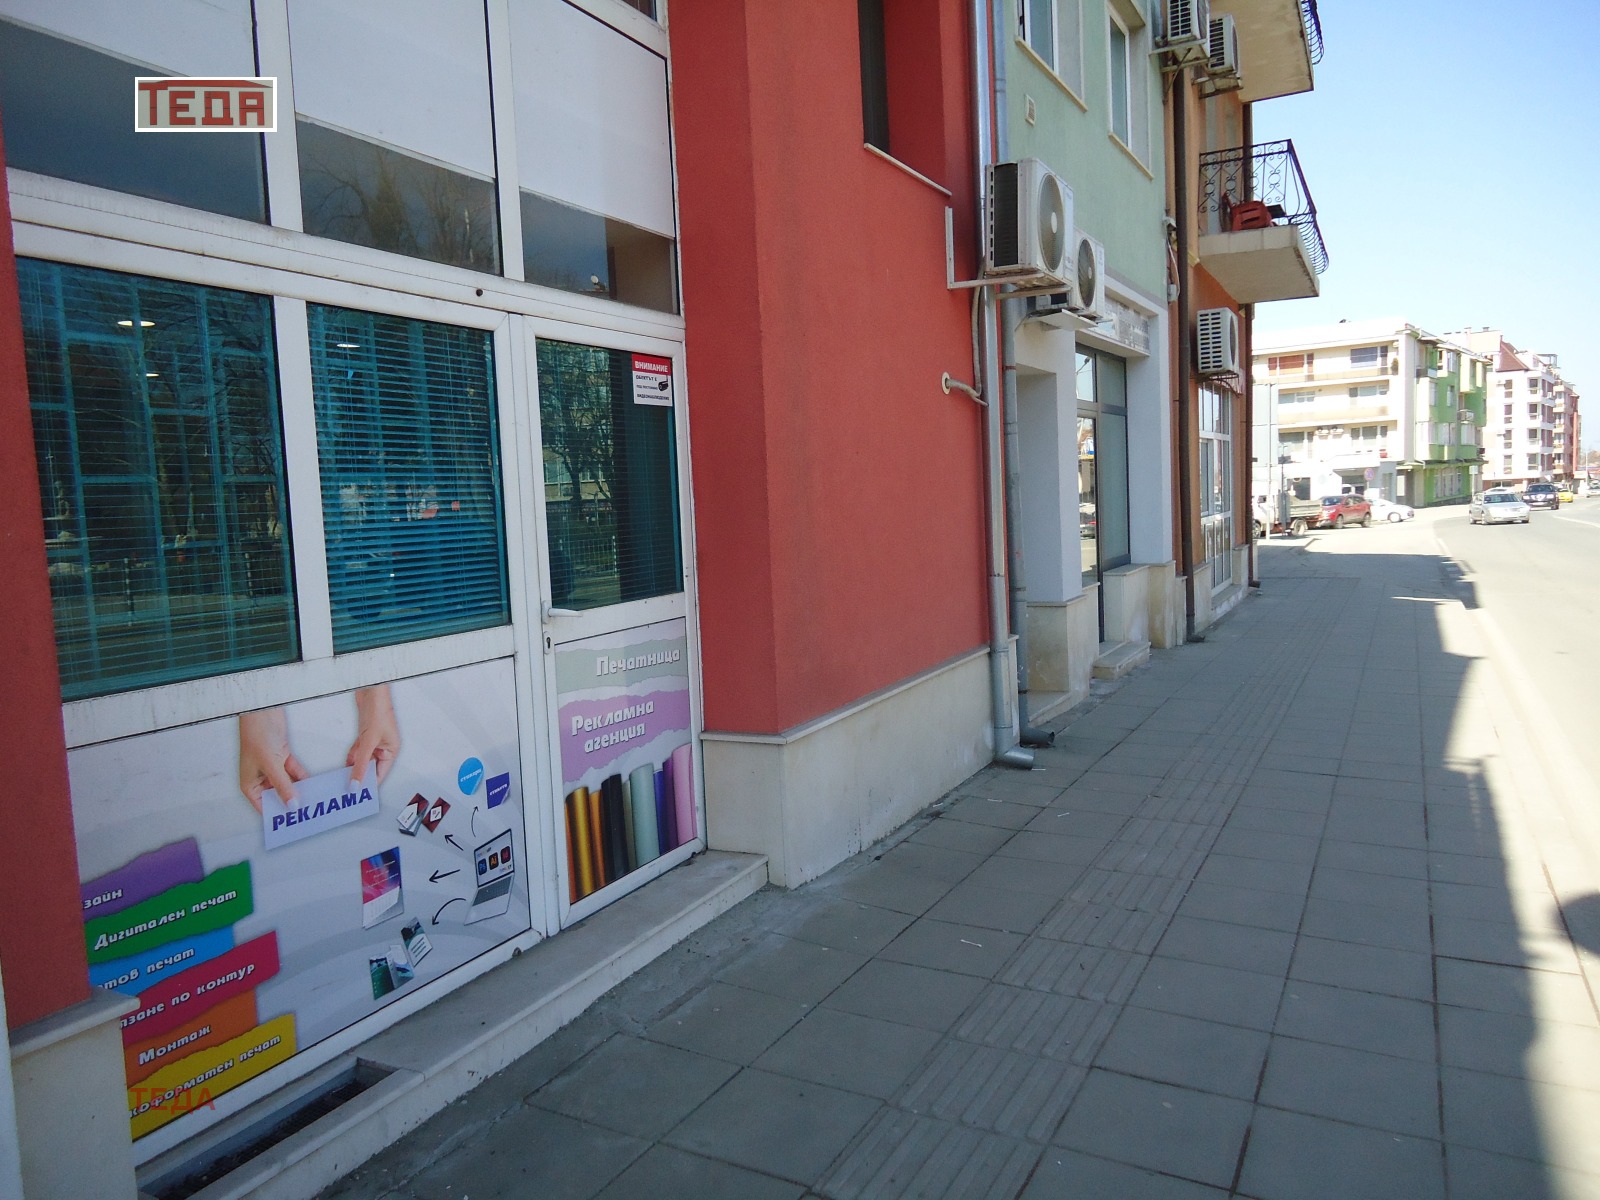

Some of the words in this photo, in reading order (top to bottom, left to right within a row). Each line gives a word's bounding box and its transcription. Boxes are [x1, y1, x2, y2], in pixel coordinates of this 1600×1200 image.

[635, 361, 668, 372] ВНИМАНИЕ
[596, 648, 681, 676] Печатница
[571, 700, 655, 737] Рекламна
[584, 723, 646, 754] агенция
[272, 787, 373, 831] РЕКЛАМА
[82, 888, 123, 911] зайн
[94, 909, 186, 951] Дигитален
[190, 889, 238, 914] печат
[97, 967, 140, 991] тов
[146, 948, 195, 974] печат
[170, 991, 191, 1007] по
[196, 963, 256, 997] контур
[138, 1024, 212, 1066] Монтаж
[239, 1035, 282, 1063] печат
